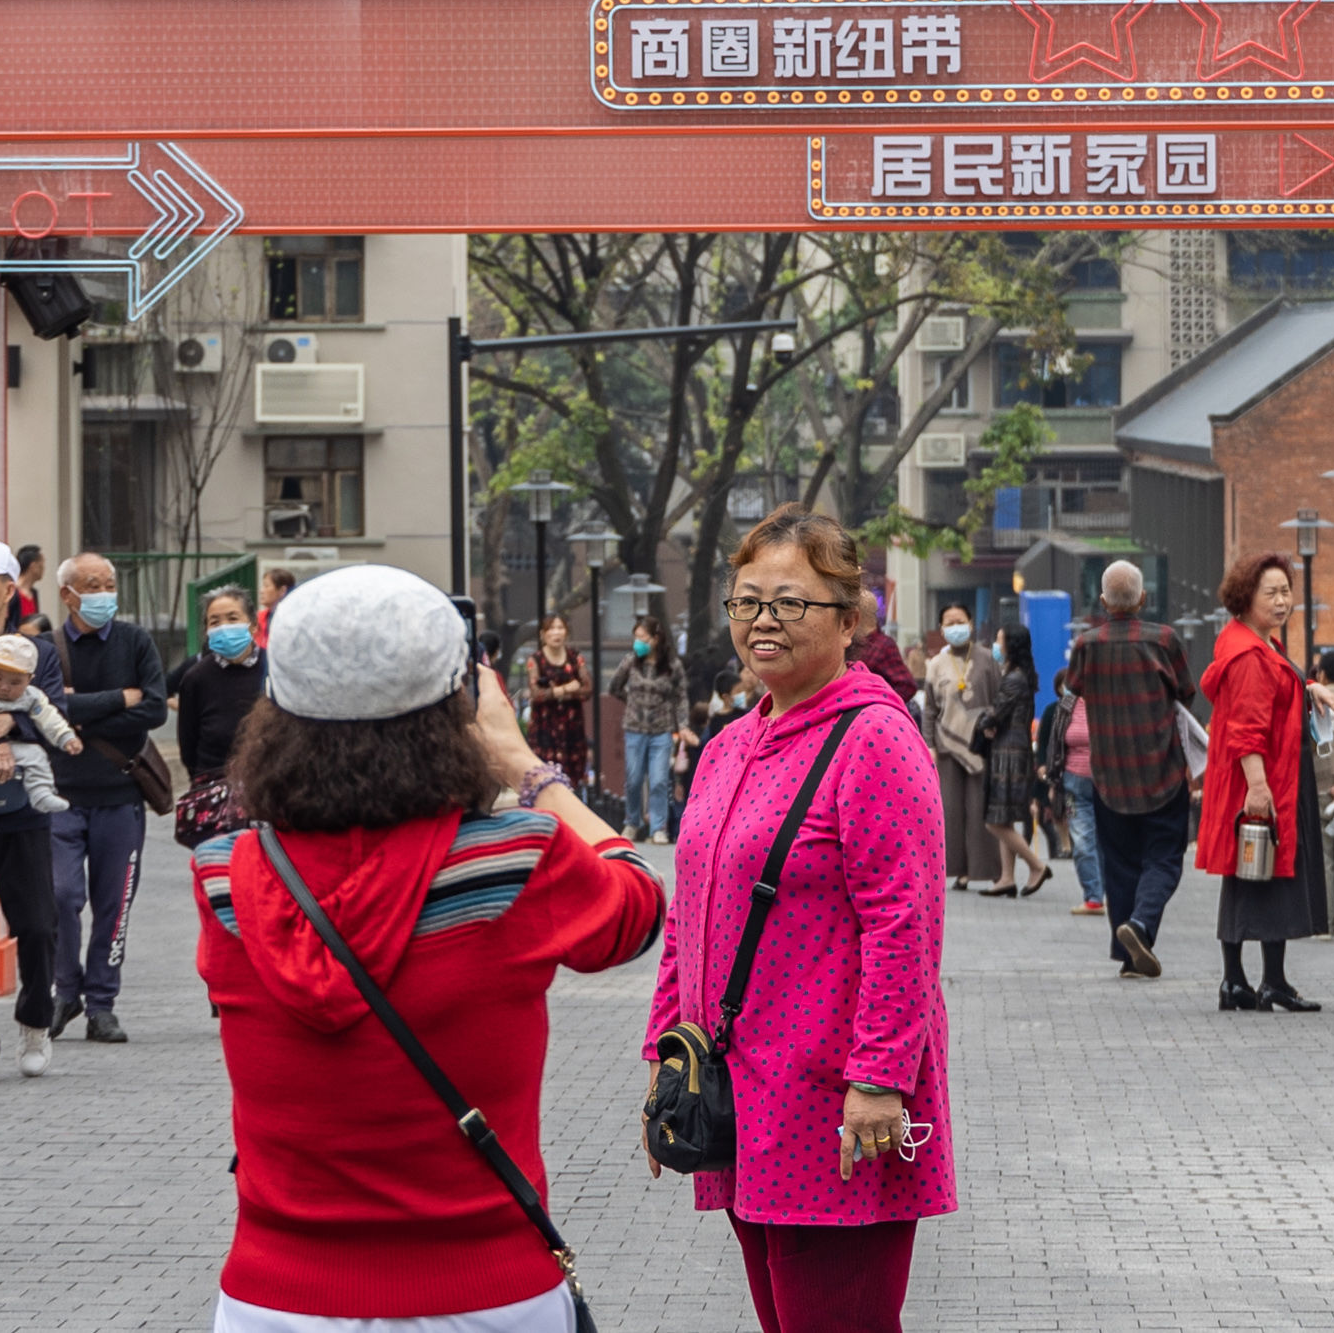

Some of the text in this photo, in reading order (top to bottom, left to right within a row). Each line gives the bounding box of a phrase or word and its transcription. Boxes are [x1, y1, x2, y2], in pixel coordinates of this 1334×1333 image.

[629, 13, 962, 81] 商圈新纽带
[870, 132, 1218, 198] 居民新家园
